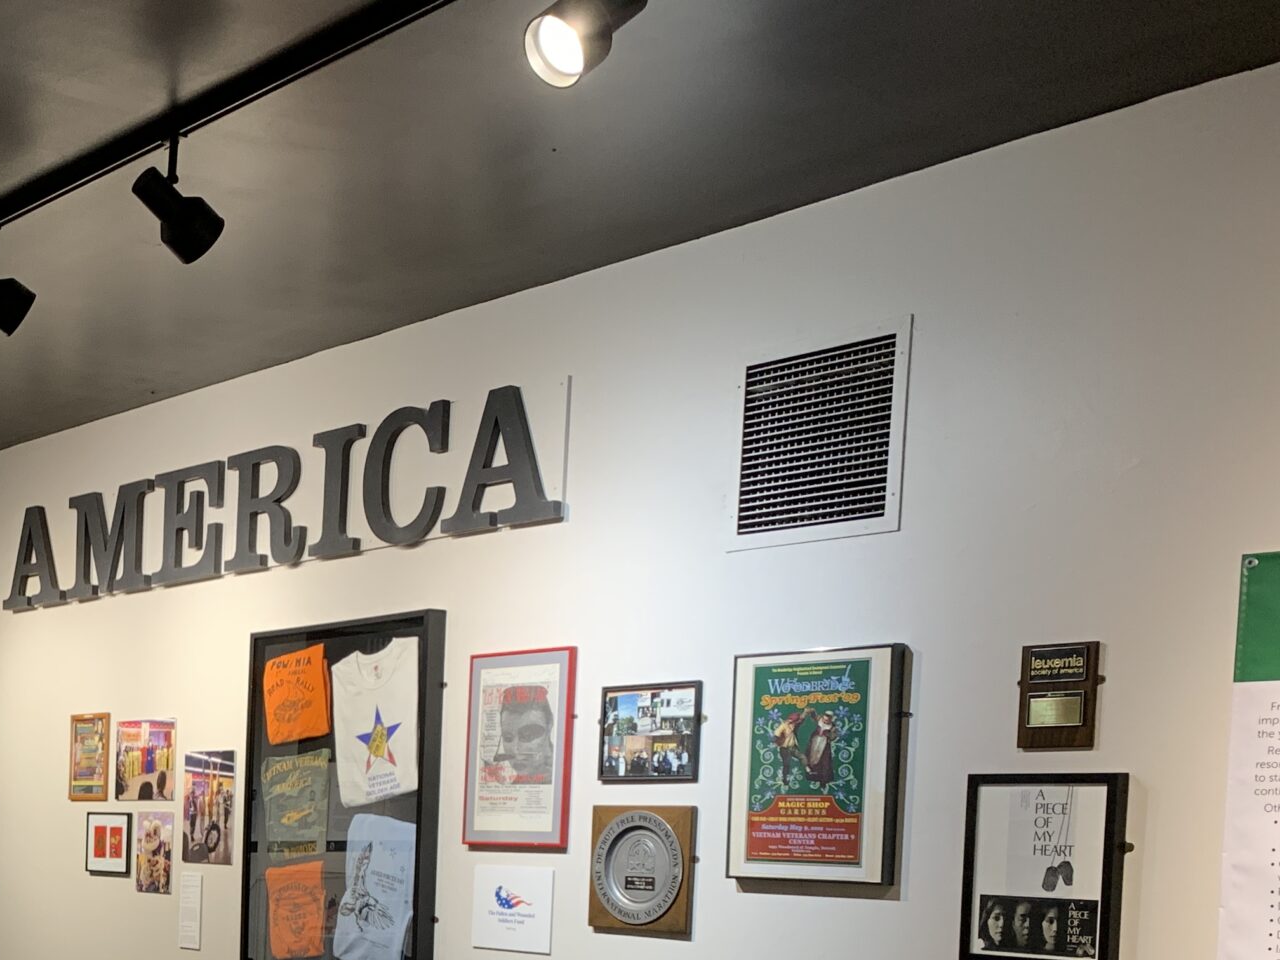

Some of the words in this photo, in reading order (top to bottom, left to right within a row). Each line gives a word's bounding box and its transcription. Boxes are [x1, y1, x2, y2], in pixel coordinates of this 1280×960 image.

[3, 385, 565, 611] AMERICA
[1031, 654, 1083, 669] leukemia
[1031, 668, 1051, 676] society
[267, 679, 285, 697] ROAD
[295, 676, 314, 693] RALLY
[1257, 730, 1275, 739] the
[1256, 761, 1280, 769] reso
[1254, 774, 1266, 782] to
[1269, 775, 1280, 783] st
[1035, 789, 1045, 801] A
[1254, 787, 1280, 796] cont
[807, 801, 830, 809] SHOP
[1035, 803, 1069, 815] PIECE
[1034, 816, 1053, 829] OF
[596, 827, 616, 864] DETROIT
[615, 815, 635, 829] FREE
[1033, 831, 1055, 843] MY
[1033, 844, 1075, 857] HEART
[596, 871, 642, 920] INTERNATIONAL
[644, 874, 679, 919] MARATHON
[1068, 901, 1076, 910] A
[1068, 910, 1090, 919] PIECE
[1068, 918, 1080, 927] OF
[1067, 927, 1081, 935] MY
[1067, 935, 1093, 944] HEART
